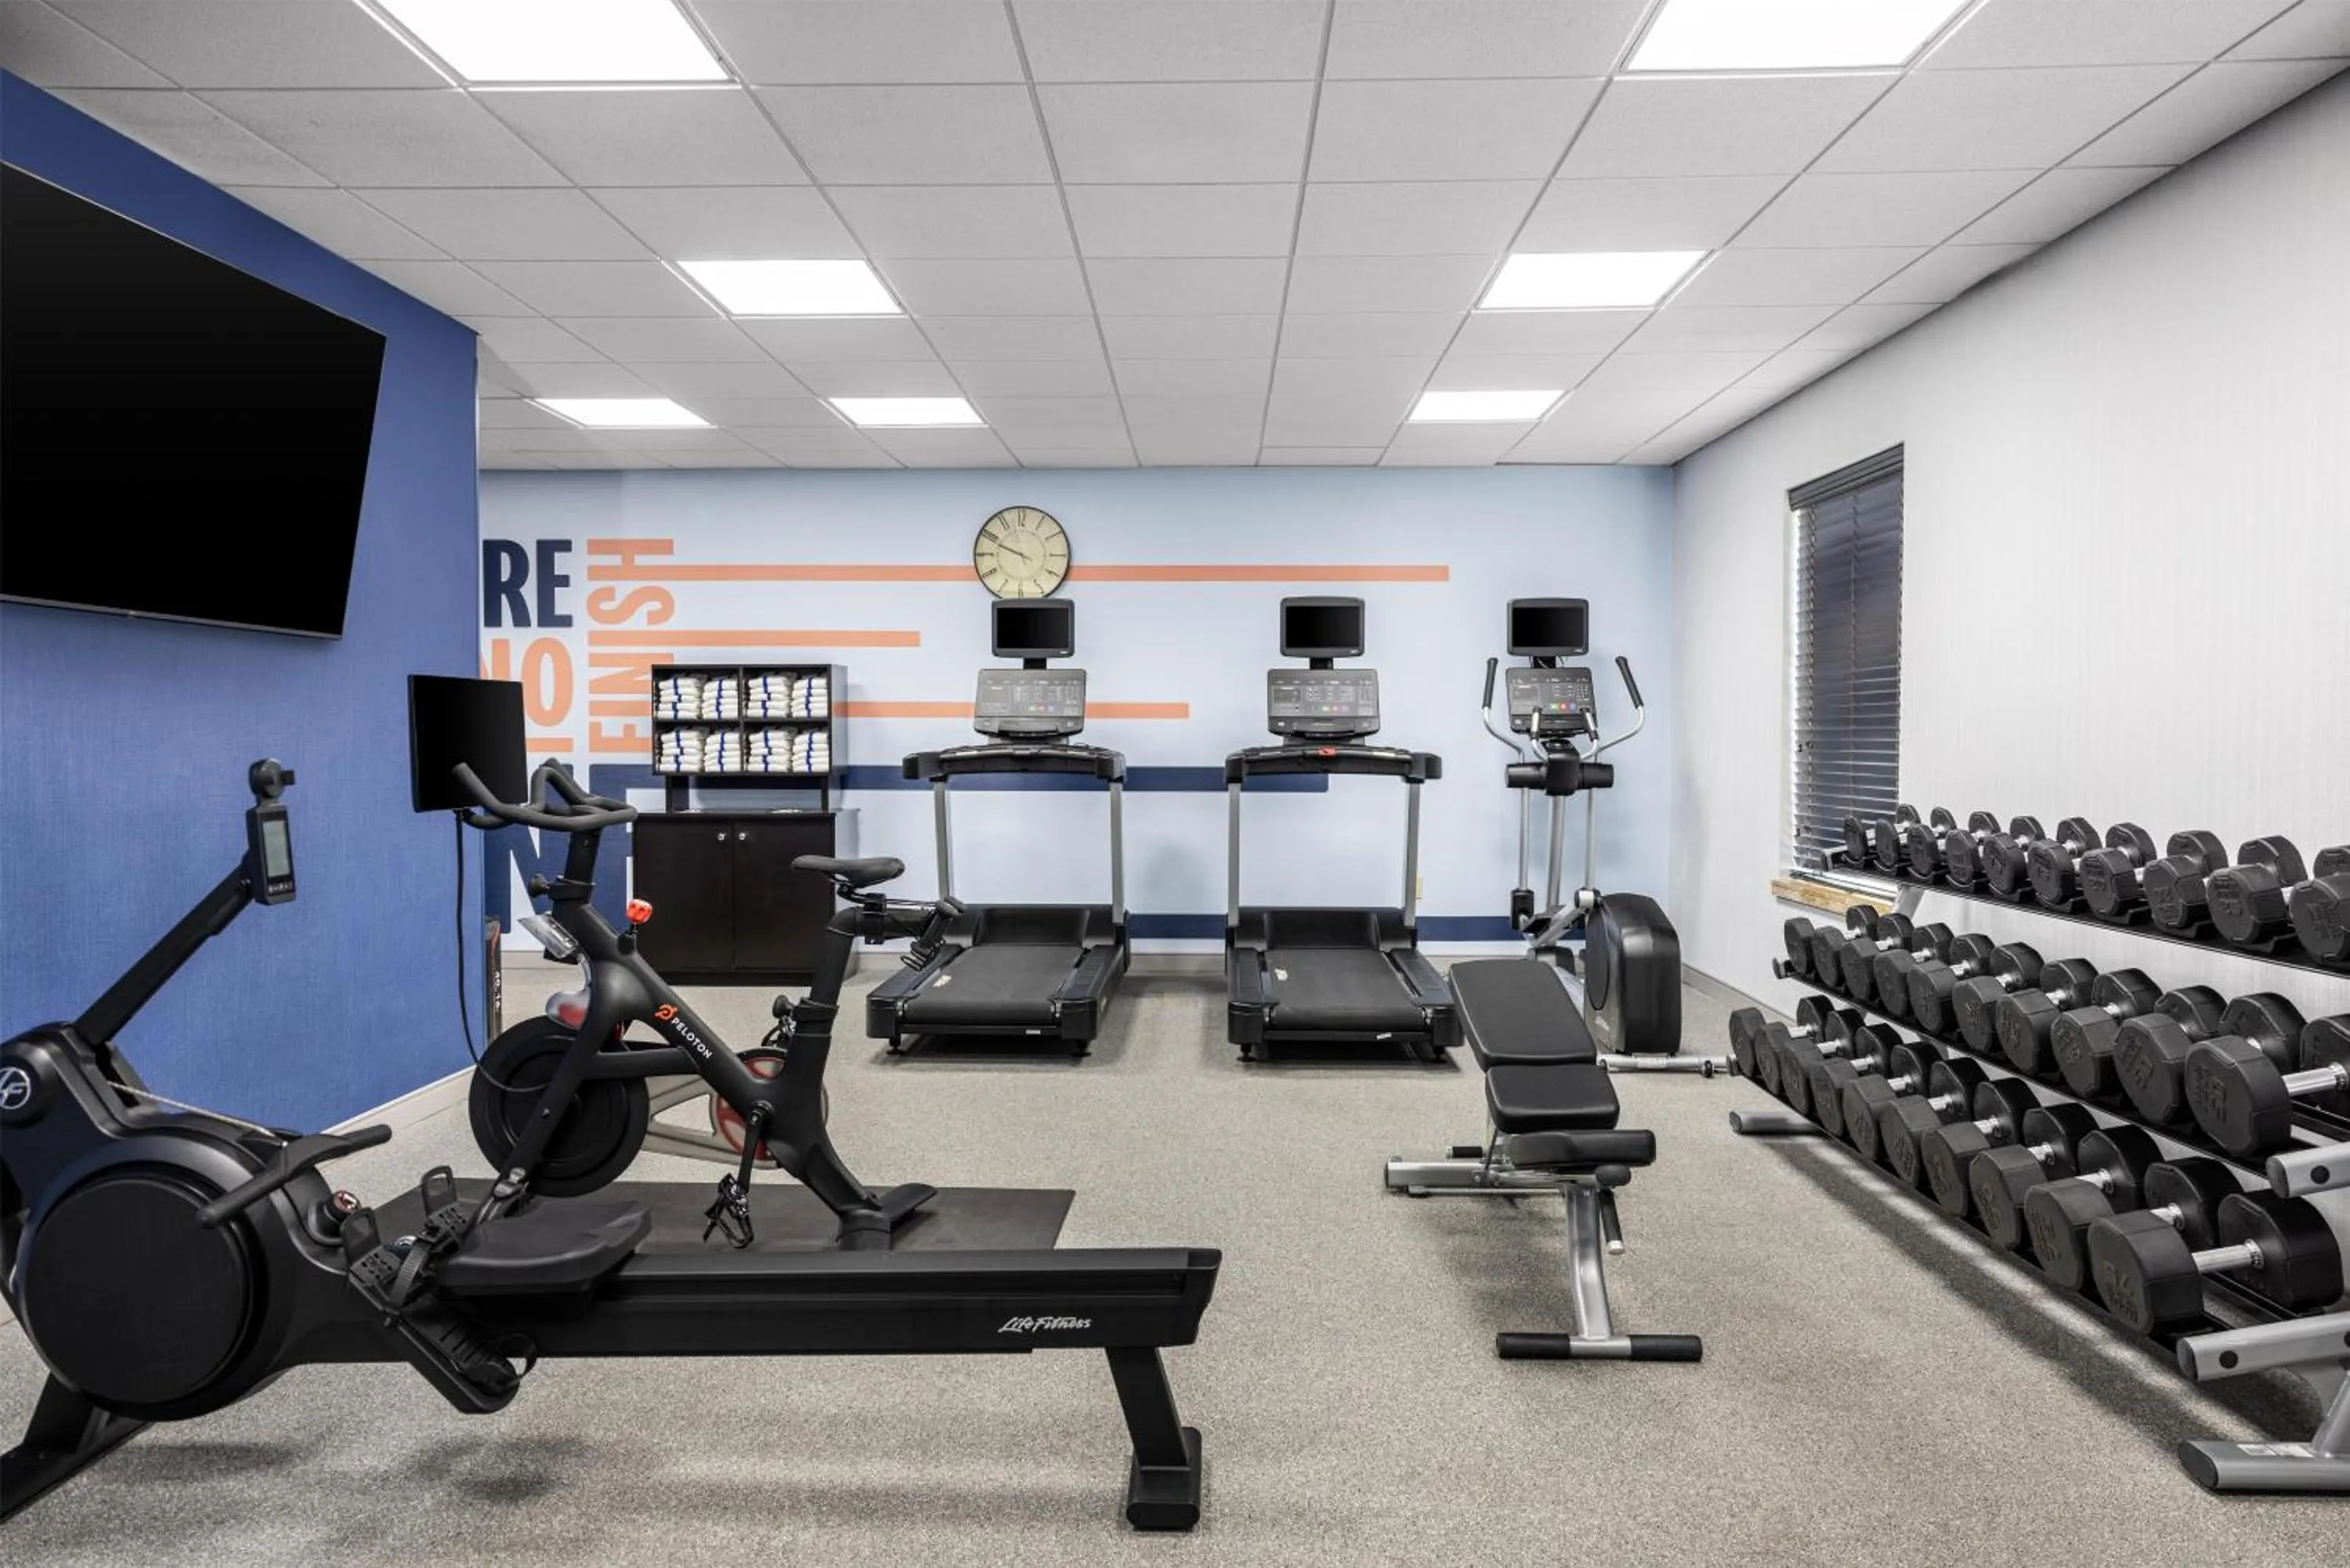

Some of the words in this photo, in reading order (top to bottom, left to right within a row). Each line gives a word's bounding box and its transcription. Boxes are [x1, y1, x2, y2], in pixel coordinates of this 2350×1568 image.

[483, 539, 573, 628] RE
[479, 636, 574, 728] O
[587, 538, 674, 753] FINISH
[671, 1017, 713, 1060] PELOTON
